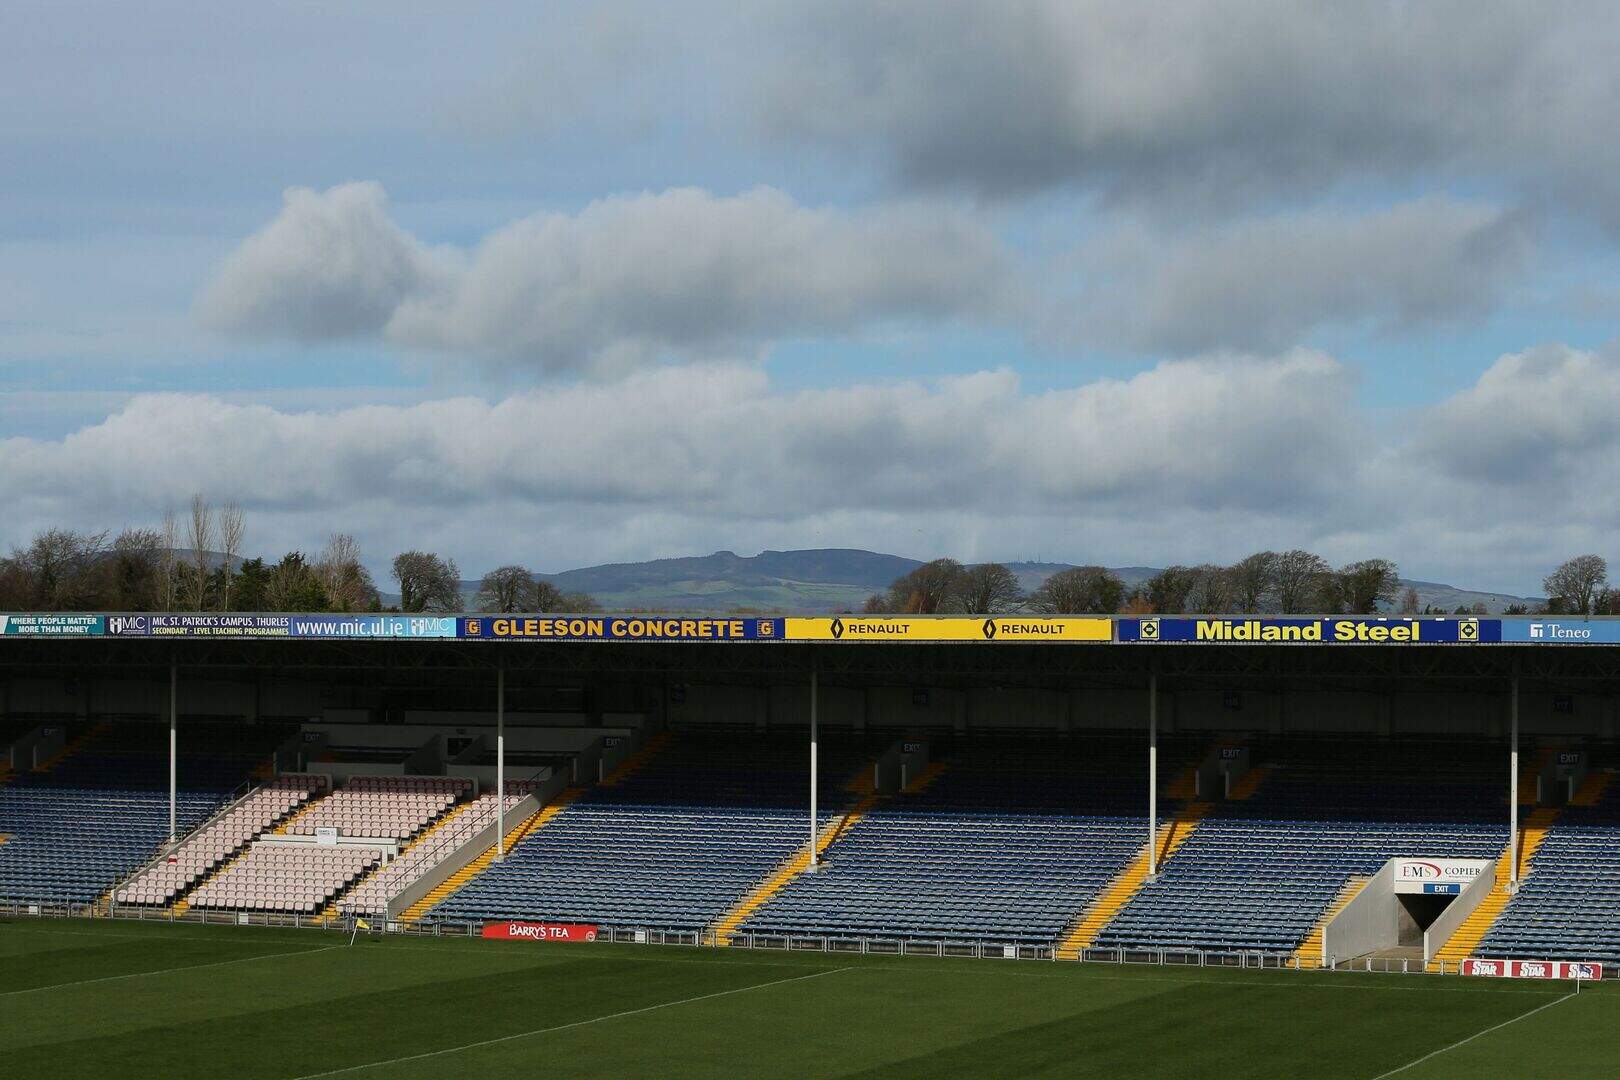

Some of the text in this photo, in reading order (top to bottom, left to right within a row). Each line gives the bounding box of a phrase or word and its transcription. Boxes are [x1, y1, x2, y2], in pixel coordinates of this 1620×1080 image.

[11, 617, 97, 625] WHERE PEOPLE MATTER
[122, 617, 145, 629] MIC
[152, 617, 289, 627] MIC, ST. PATRICK'S CAMPUS, THURLES
[296, 618, 403, 635] www.mic.ul.ie
[424, 618, 449, 631] MIC
[244, 628, 289, 636] PROGRAMMES
[493, 619, 744, 637] GLEESON CONCRETE
[848, 624, 910, 634] RENAULT
[1001, 624, 1065, 634] RENAULT
[1196, 620, 1420, 641] Midland Steel
[1548, 624, 1592, 638] Teneo
[903, 743, 921, 752] EXIT
[1222, 749, 1240, 759] EXIT
[1560, 753, 1579, 764] EXIT
[1402, 867, 1433, 878] EMS
[1434, 885, 1449, 893] EXIT
[509, 924, 569, 940] BARRY'S TEA
